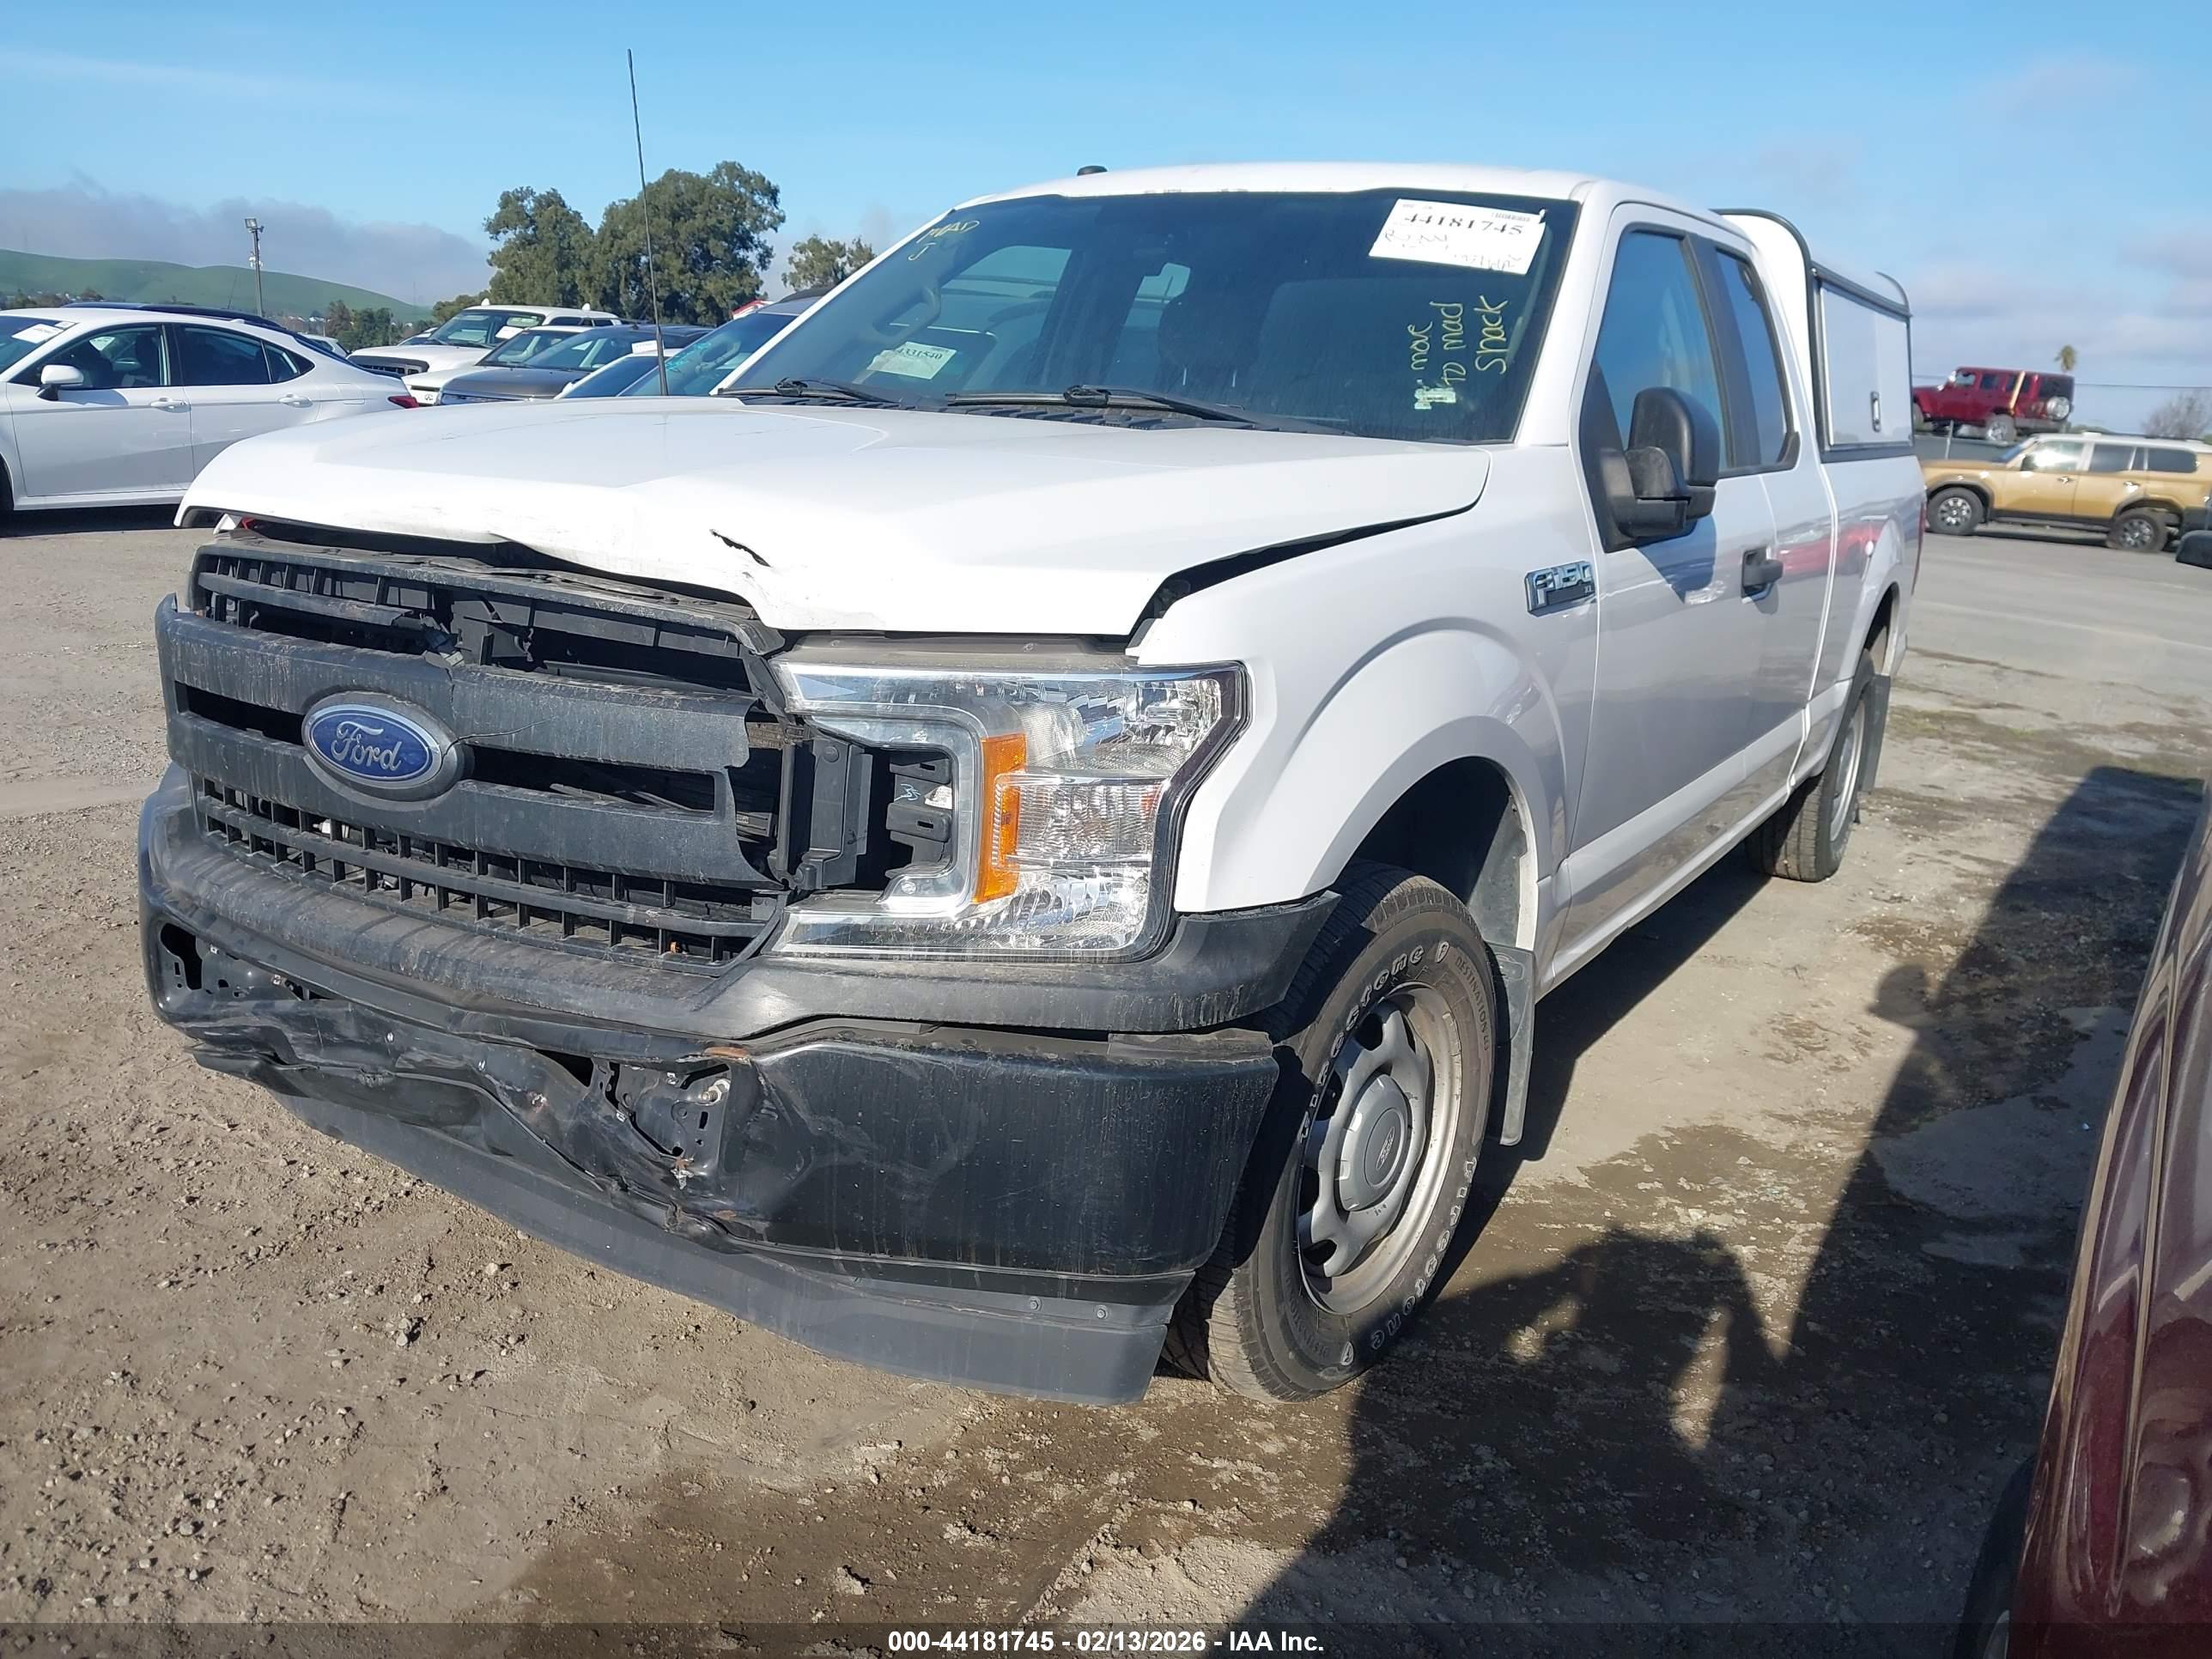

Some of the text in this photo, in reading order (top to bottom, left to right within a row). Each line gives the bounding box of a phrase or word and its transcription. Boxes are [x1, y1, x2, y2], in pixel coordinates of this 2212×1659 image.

[1404, 213, 1523, 236] 44181745
[1429, 301, 1467, 350] mad
[330, 720, 403, 771] Ford
[1455, 957, 1488, 1034] DESTINATION
